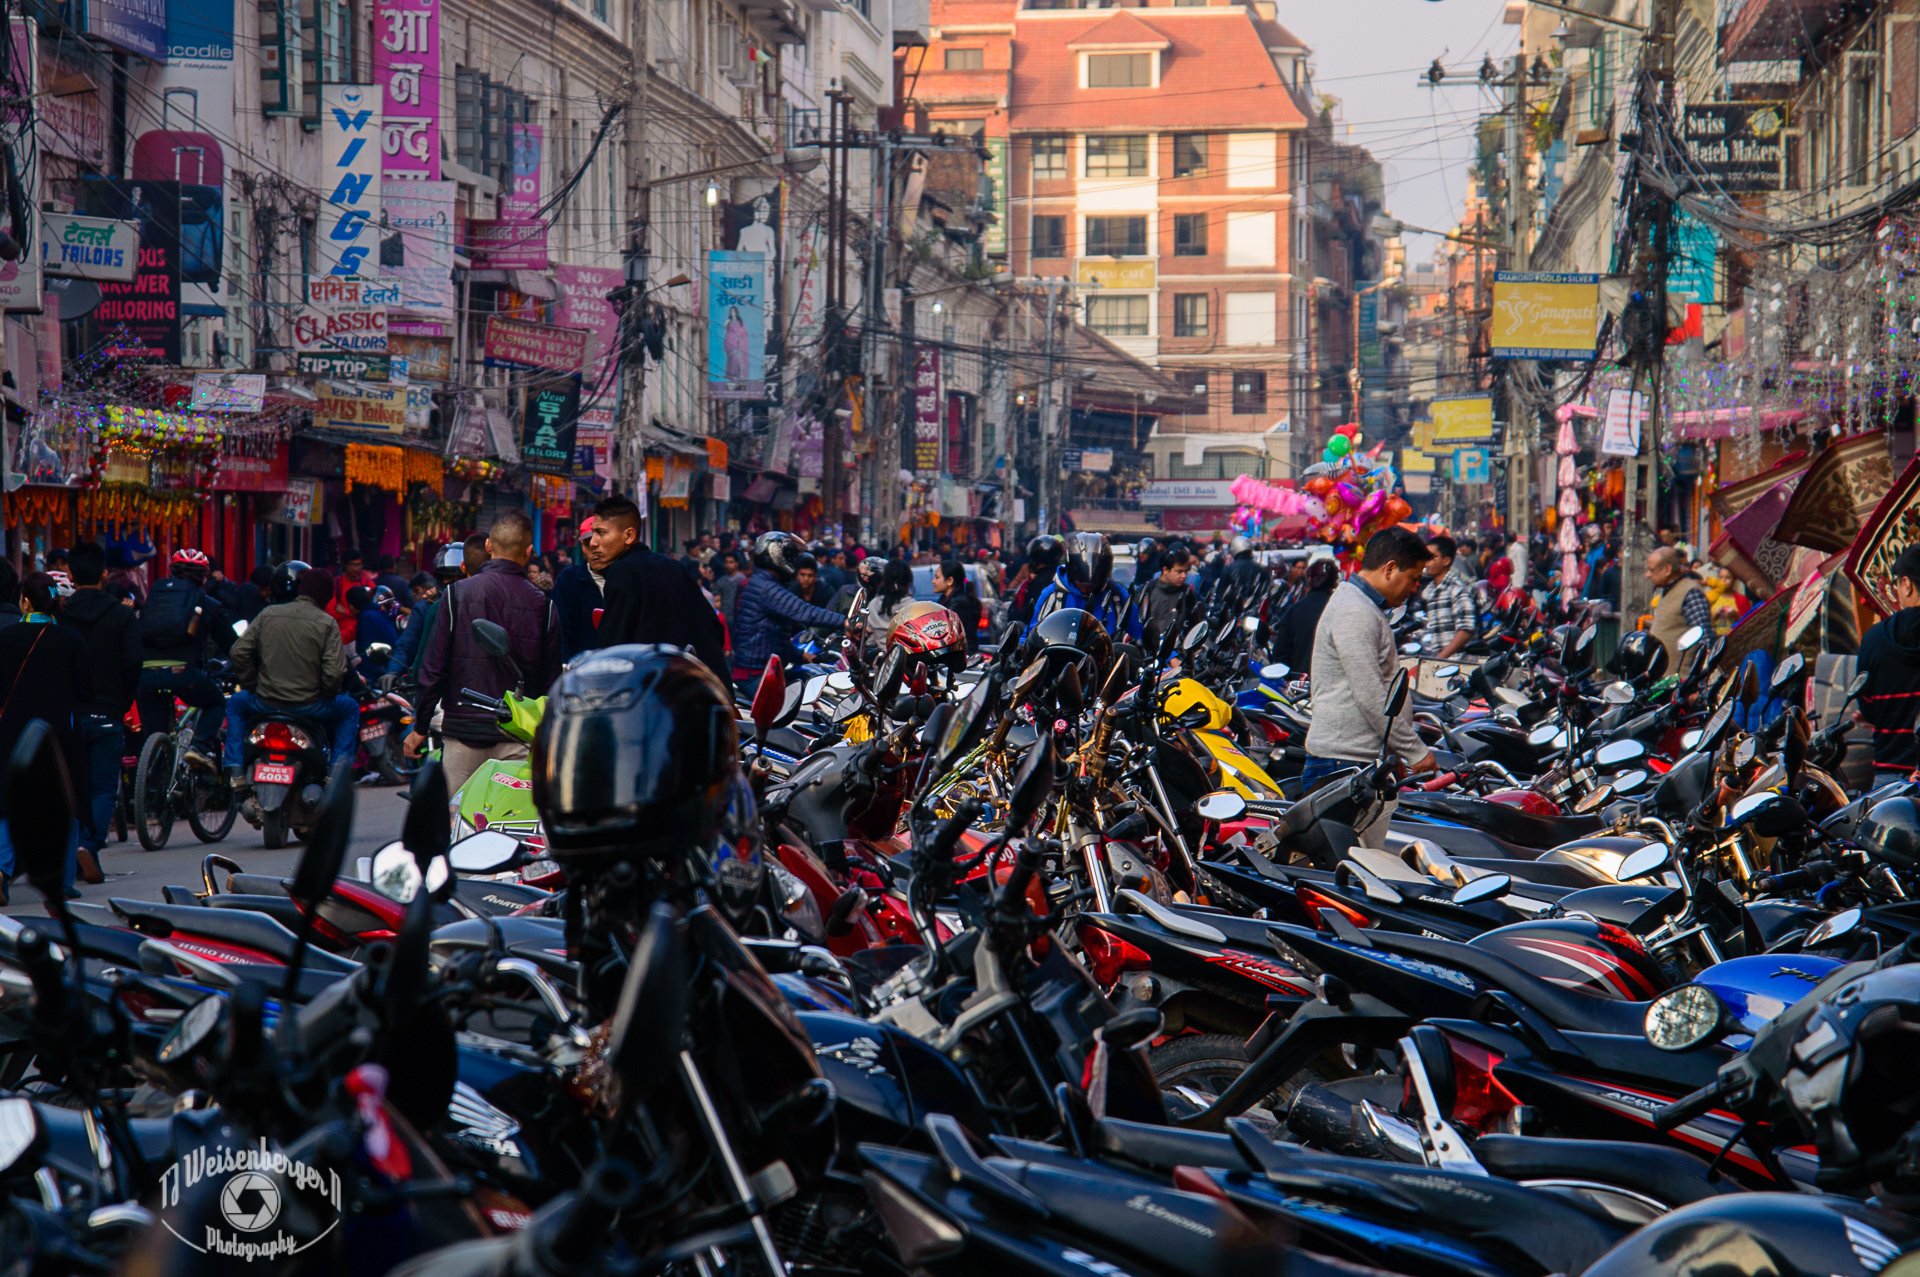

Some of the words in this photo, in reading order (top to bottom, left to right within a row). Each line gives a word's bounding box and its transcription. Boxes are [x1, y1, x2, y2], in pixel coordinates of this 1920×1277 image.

[1688, 111, 1726, 134] Swiss
[1689, 140, 1729, 162] Watch
[329, 109, 374, 276] WINGS
[61, 244, 124, 267] TAILORS
[1498, 272, 1534, 281] DIAMOND
[1541, 273, 1561, 282] GOLD
[1568, 274, 1594, 283] SILVER
[1530, 303, 1596, 325] Ganapati
[295, 312, 385, 345] CLASSIC
[334, 336, 387, 349] TAILORS
[490, 331, 542, 349] FASHION
[493, 345, 505, 355] &
[301, 356, 331, 374] TIP
[332, 359, 367, 379] TOP
[407, 387, 430, 408] RS
[361, 401, 405, 424] Tailors
[535, 401, 560, 448] STAR
[523, 445, 568, 459] TAILORS
[1460, 450, 1483, 481] P
[178, 942, 218, 957] HERO
